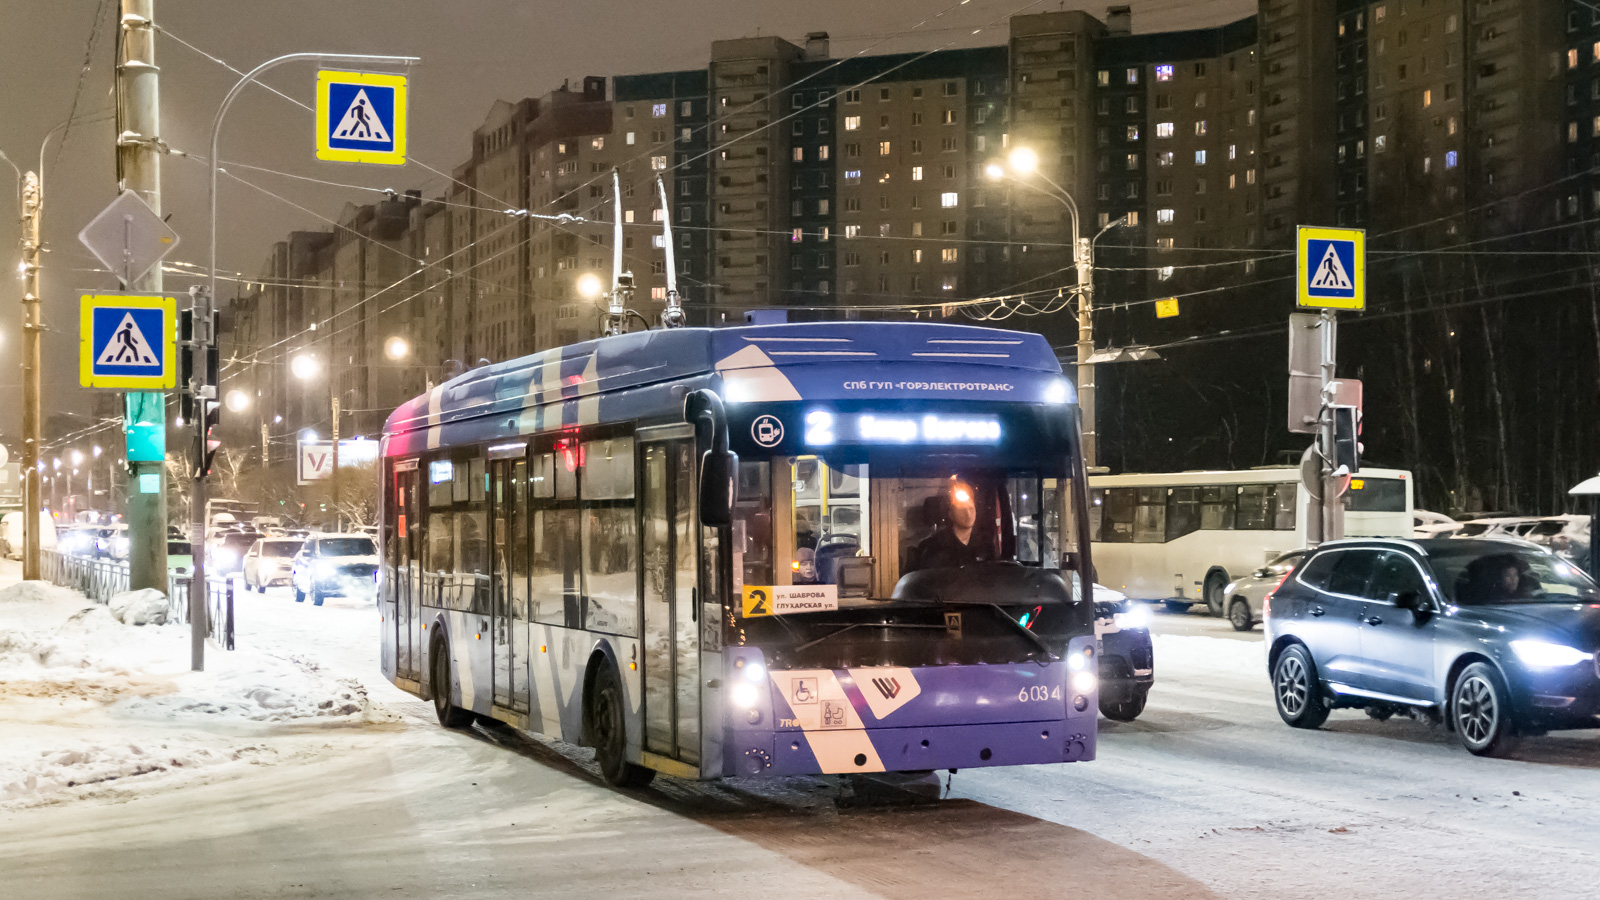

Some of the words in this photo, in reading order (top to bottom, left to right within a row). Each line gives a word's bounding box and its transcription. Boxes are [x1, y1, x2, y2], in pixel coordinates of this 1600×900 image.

[869, 381, 893, 390] ГУП
[895, 381, 1014, 391] «ГОРЭЛЕКТРОТРАНС»
[804, 409, 833, 445] 2
[749, 589, 767, 614] 2
[1018, 684, 1061, 703] 6034
